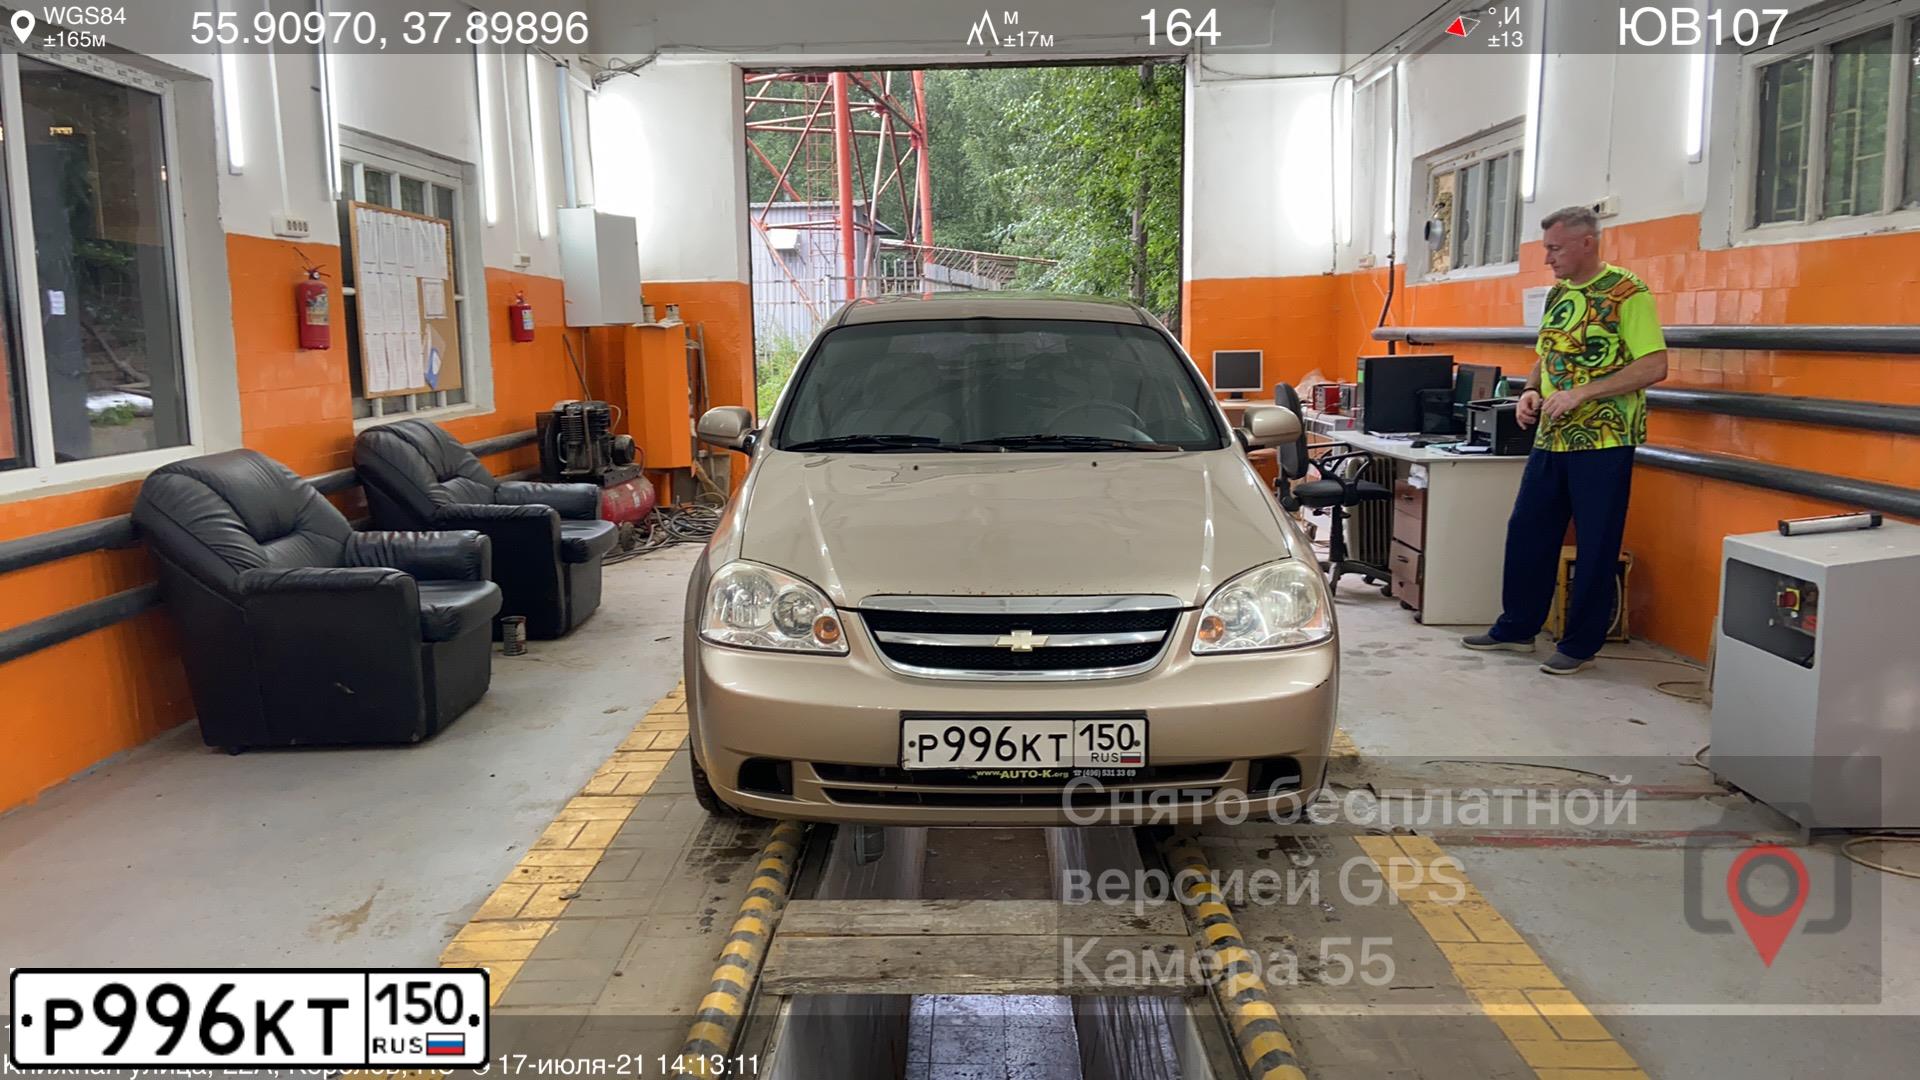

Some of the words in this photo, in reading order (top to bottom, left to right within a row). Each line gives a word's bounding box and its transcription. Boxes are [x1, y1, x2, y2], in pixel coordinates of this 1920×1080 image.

[1078, 723, 1135, 751] 150
[1090, 752, 1119, 763] RUS
[976, 769, 1069, 779] www.AUTO-K.org
